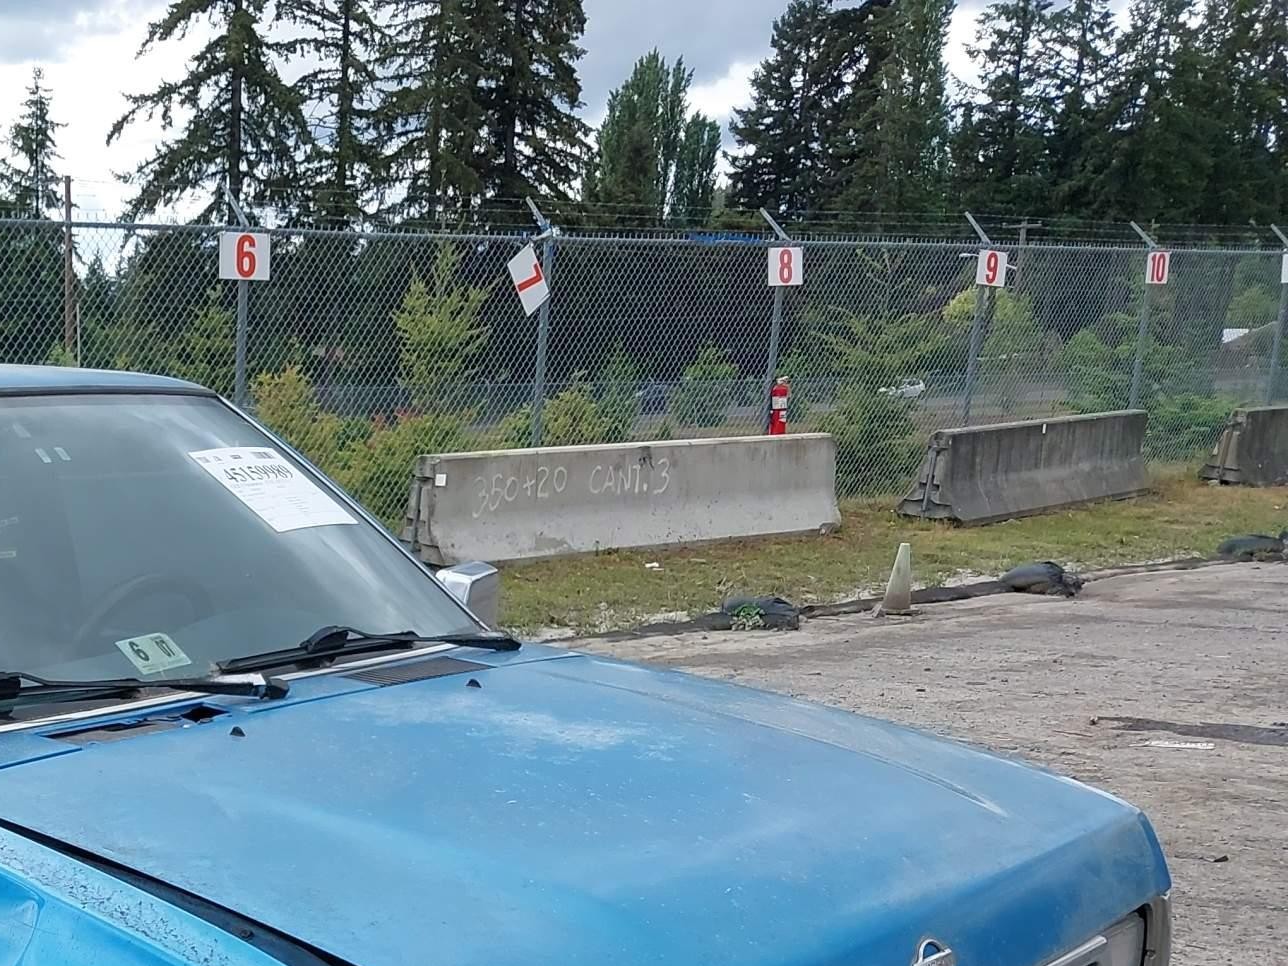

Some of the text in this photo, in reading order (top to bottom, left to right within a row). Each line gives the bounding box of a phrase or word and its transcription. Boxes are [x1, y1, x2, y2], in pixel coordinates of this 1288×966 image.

[236, 234, 256, 278] 6
[779, 249, 793, 284] 8
[985, 252, 999, 284] 9
[1151, 253, 1166, 282] 10
[516, 262, 543, 293] 7
[223, 464, 294, 483] 45159989
[128, 640, 150, 662] 6
